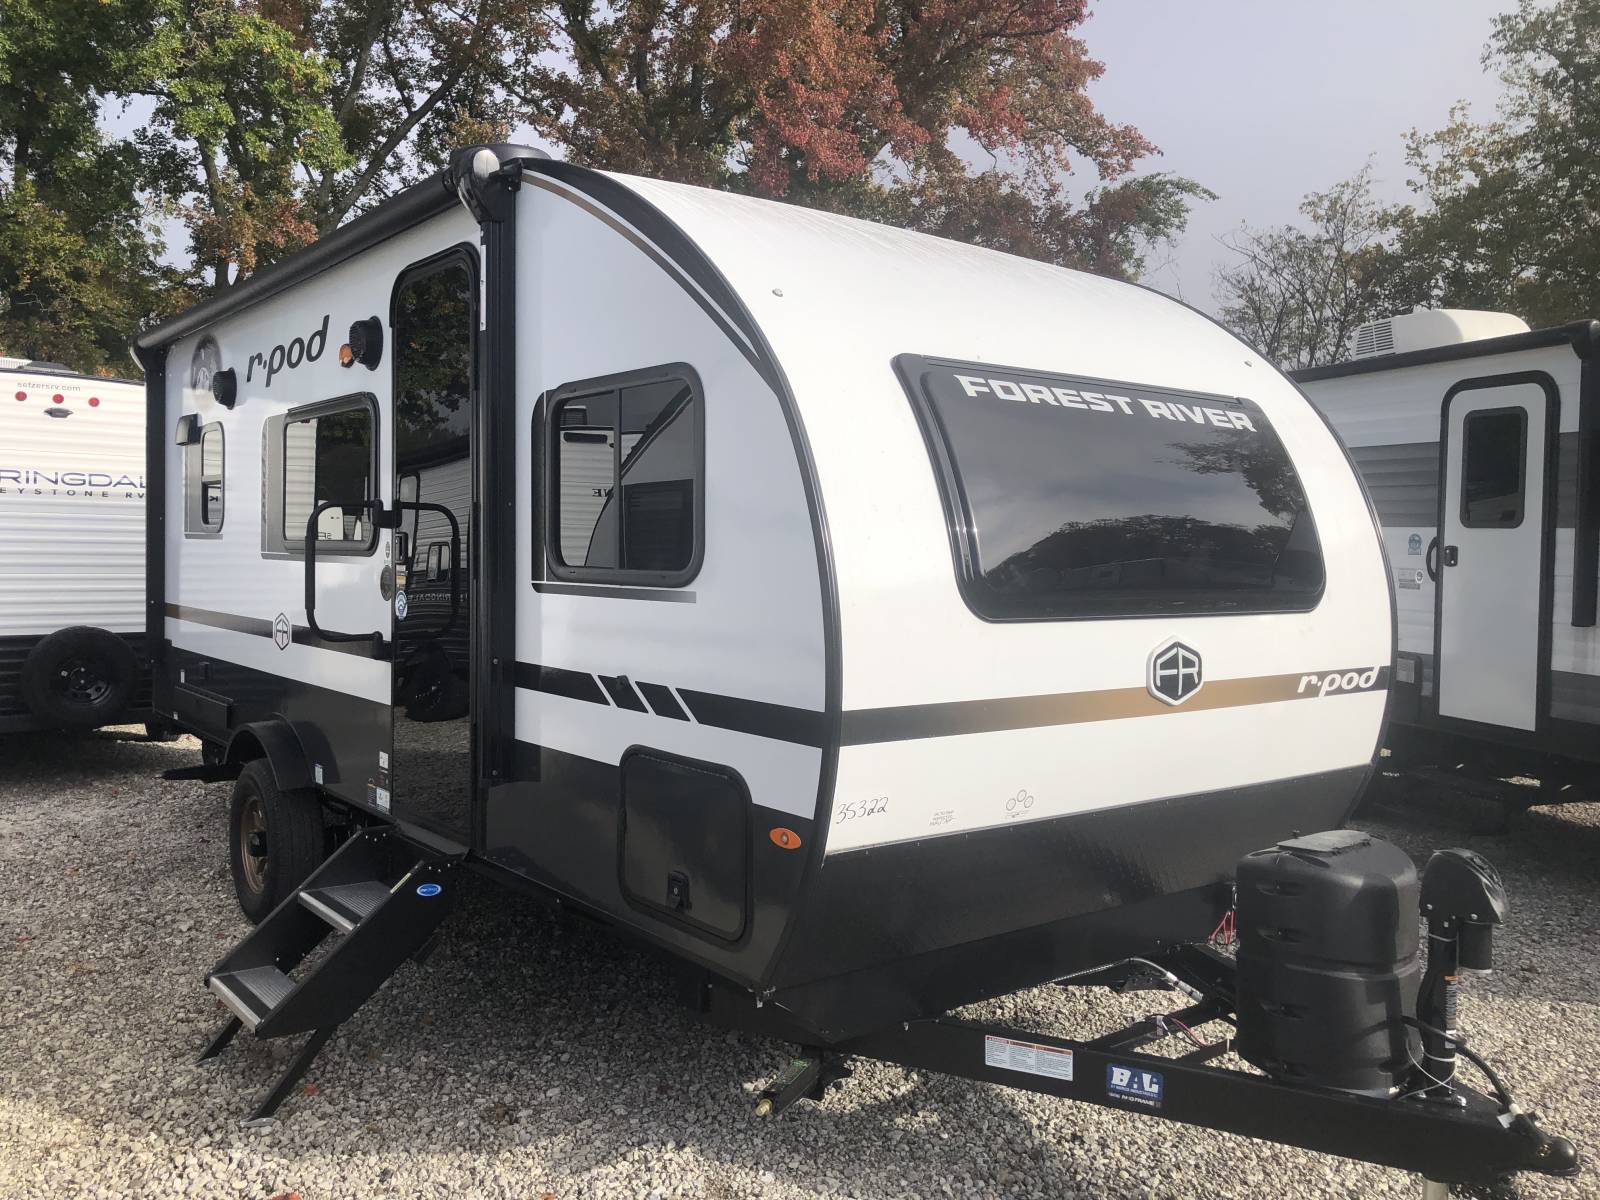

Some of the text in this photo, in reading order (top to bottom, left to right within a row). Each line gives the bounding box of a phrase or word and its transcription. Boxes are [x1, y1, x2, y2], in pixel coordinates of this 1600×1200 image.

[953, 374, 1258, 432] FOREST RIVER
[835, 796, 889, 825] 35322
